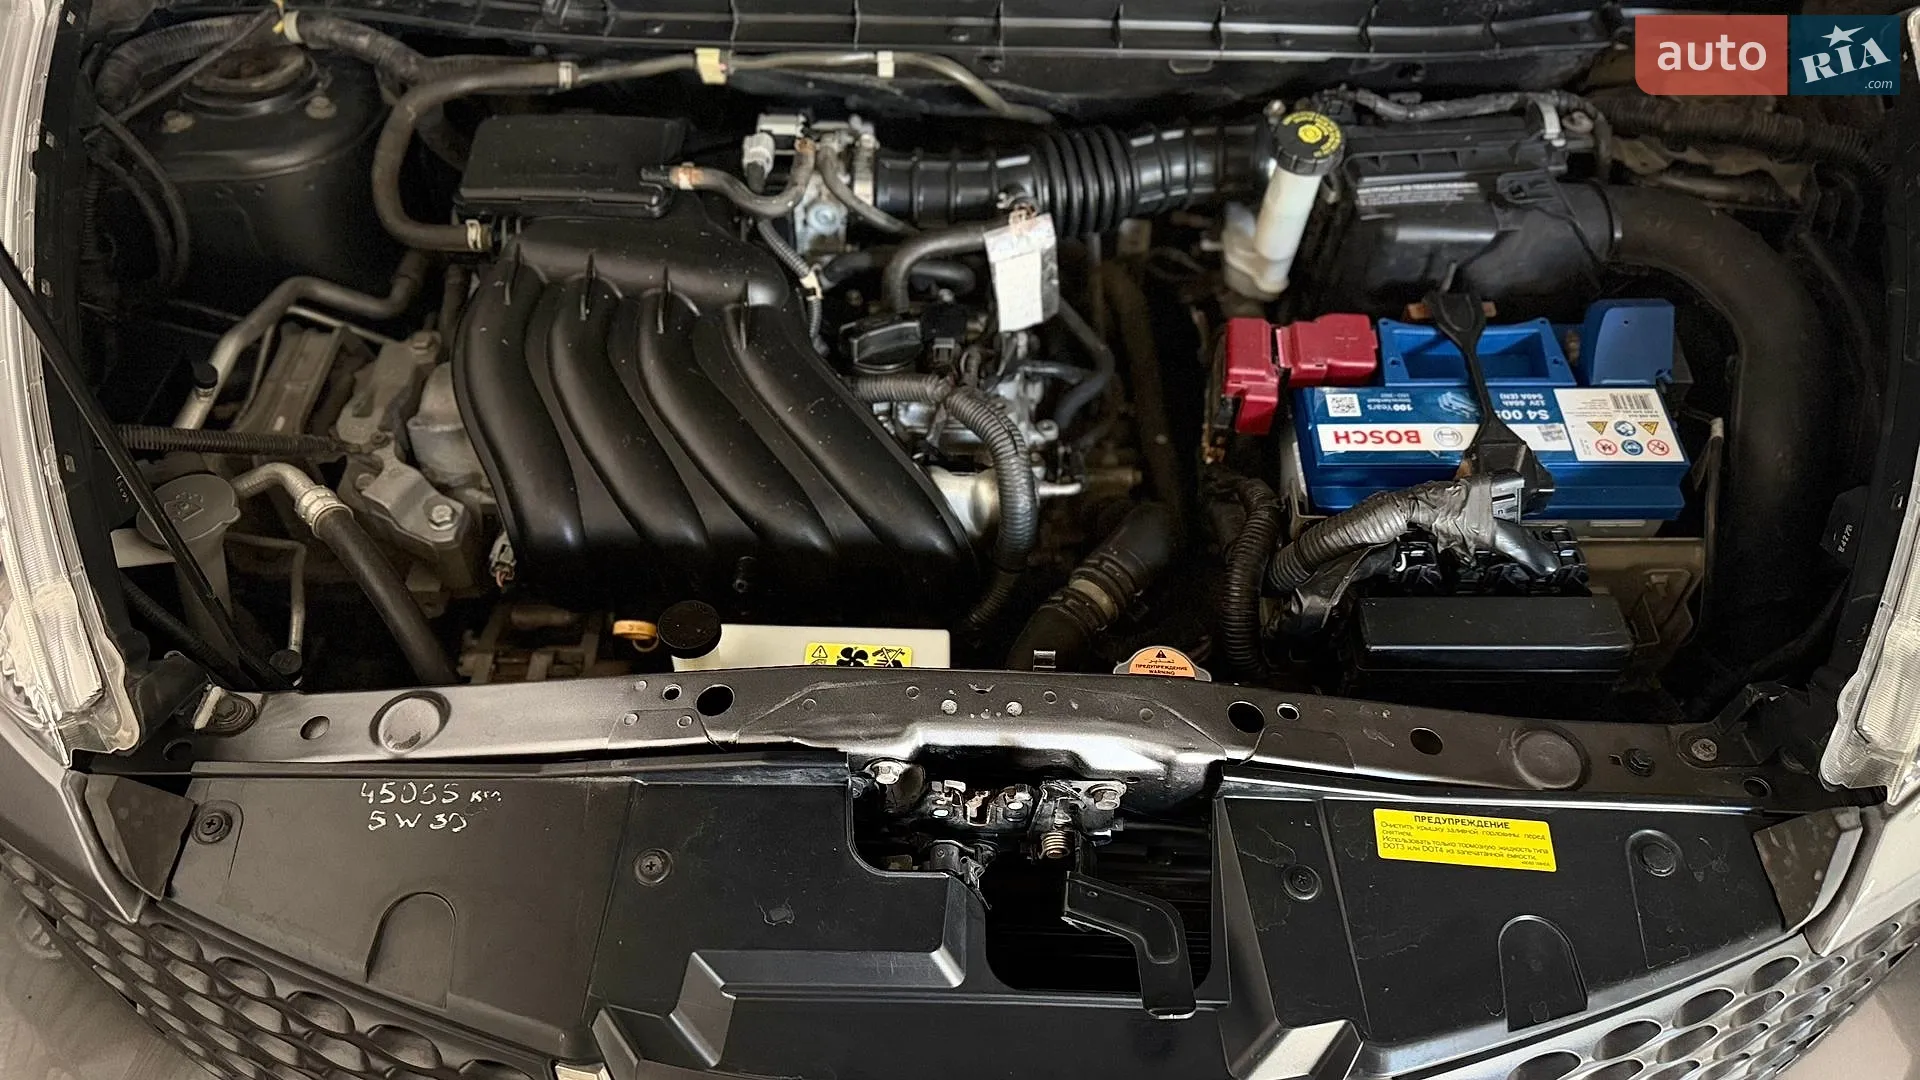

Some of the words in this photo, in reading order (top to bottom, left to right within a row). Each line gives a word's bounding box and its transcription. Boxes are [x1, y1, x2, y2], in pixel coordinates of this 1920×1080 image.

[1366, 403, 1393, 411] Years
[1393, 403, 1413, 411] 100
[1526, 409, 1550, 420] S4
[1333, 429, 1422, 445] BOSCH
[1413, 815, 1511, 830] ПРЕДУПРЕЖДЕНИЕ
